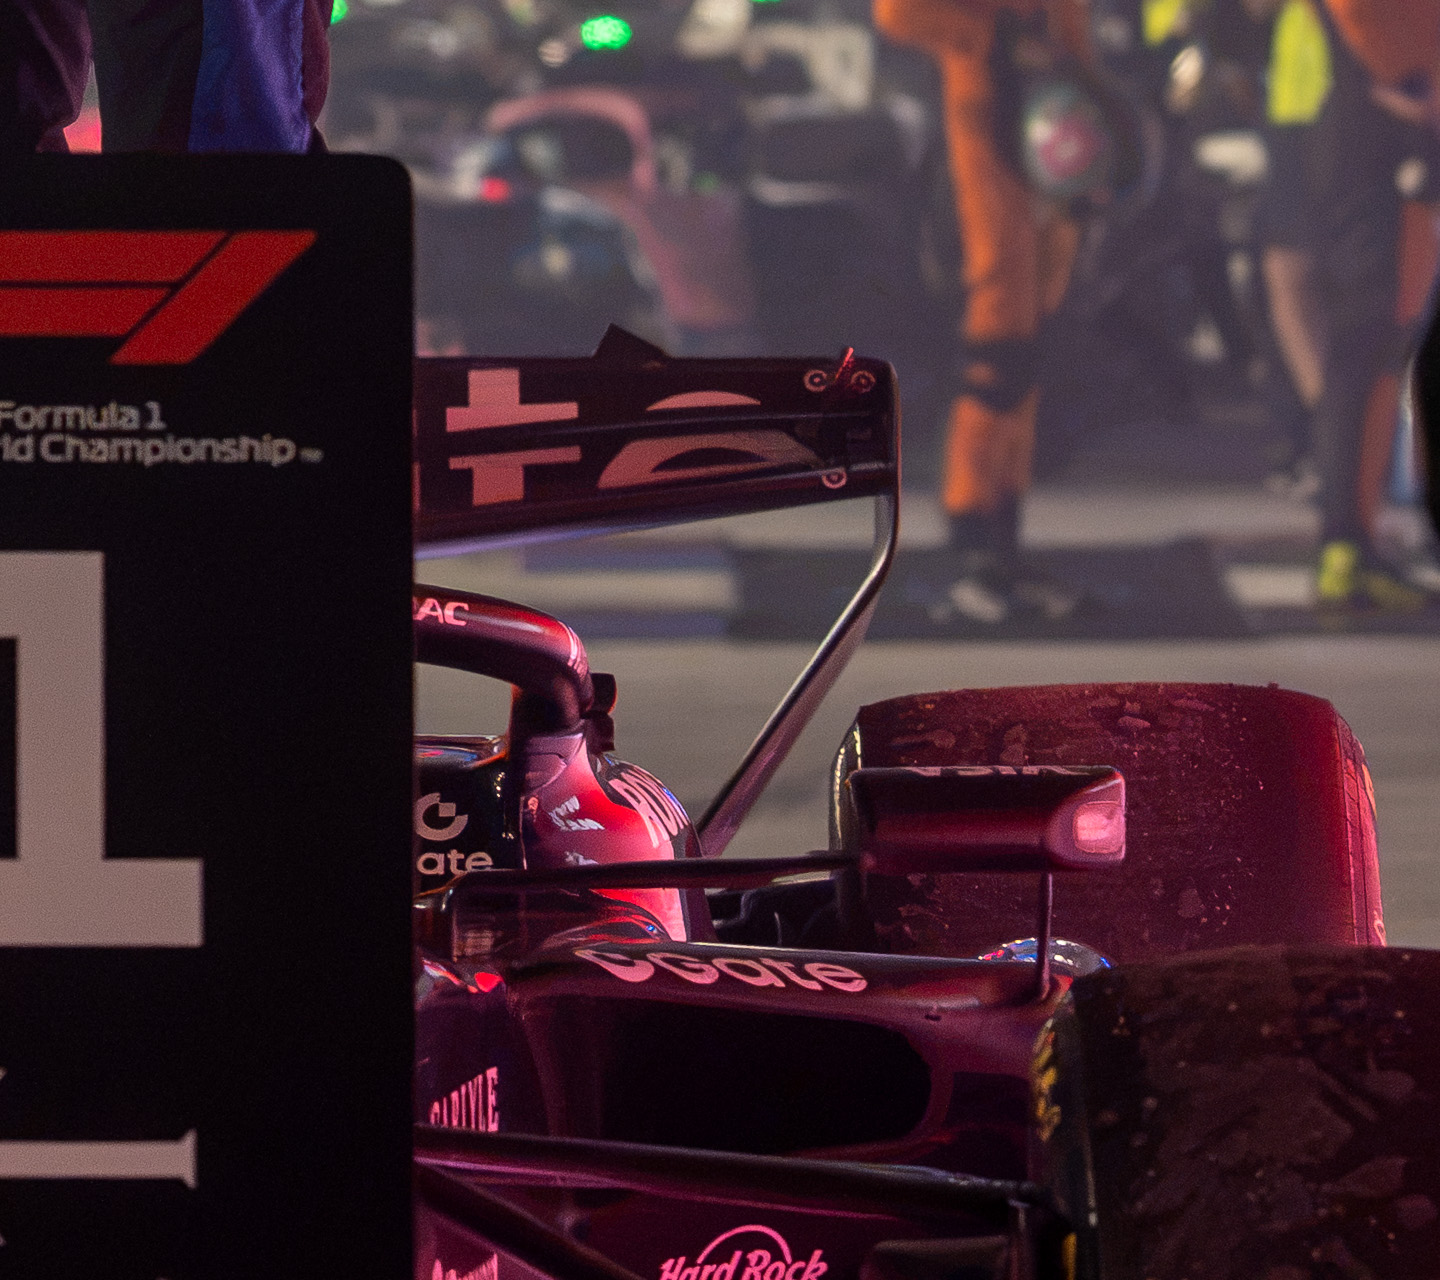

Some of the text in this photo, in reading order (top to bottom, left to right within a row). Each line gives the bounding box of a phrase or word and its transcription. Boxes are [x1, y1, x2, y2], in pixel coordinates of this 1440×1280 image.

[146, 400, 167, 430] 1
[40, 432, 298, 468] Championship
[413, 596, 470, 627] AC
[416, 848, 494, 877] ate
[660, 1249, 829, 1280] Hard Rock
